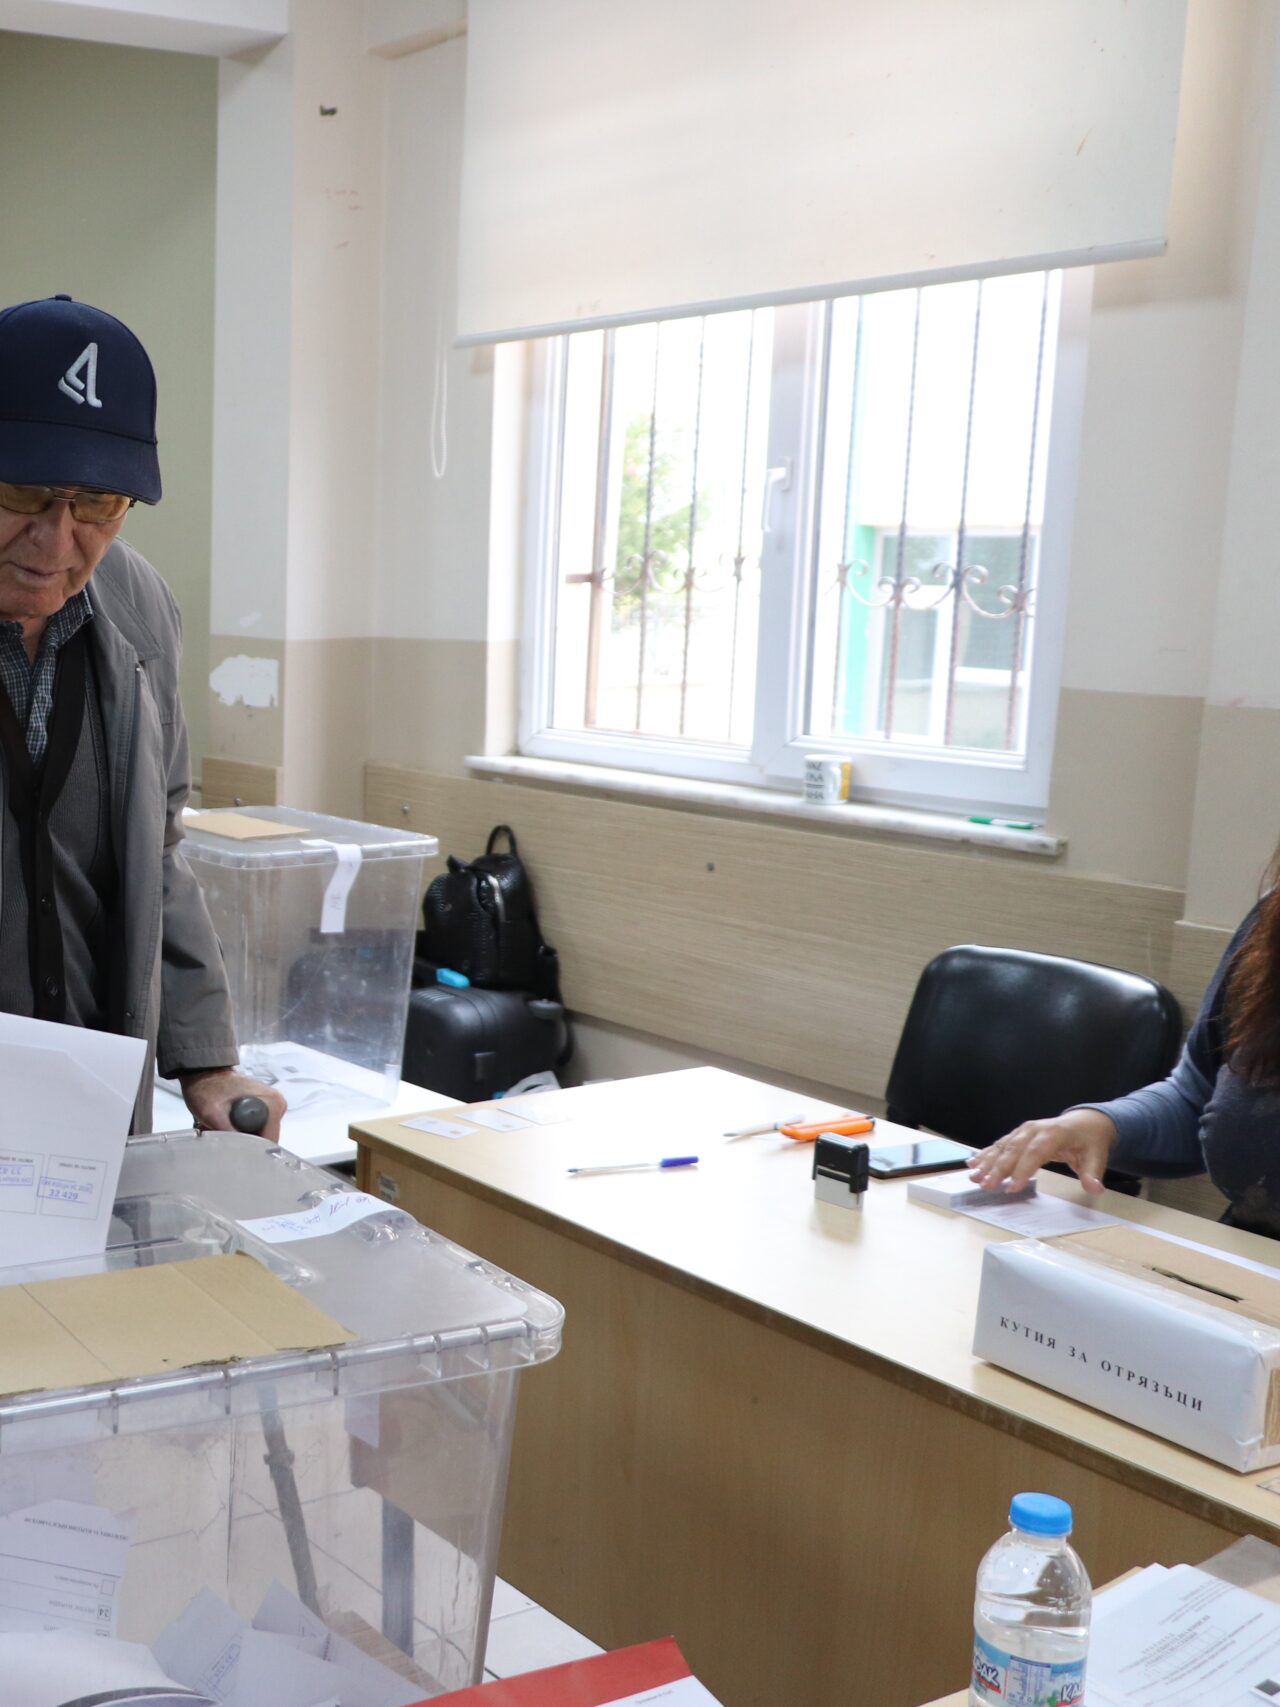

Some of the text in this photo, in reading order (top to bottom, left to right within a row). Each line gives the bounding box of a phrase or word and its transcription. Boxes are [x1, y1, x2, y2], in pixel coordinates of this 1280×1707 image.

[61, 1190, 79, 1200] 429
[999, 1315, 1204, 1413] КУТИЯ ЗА ОТРЯЗЪЦИ
